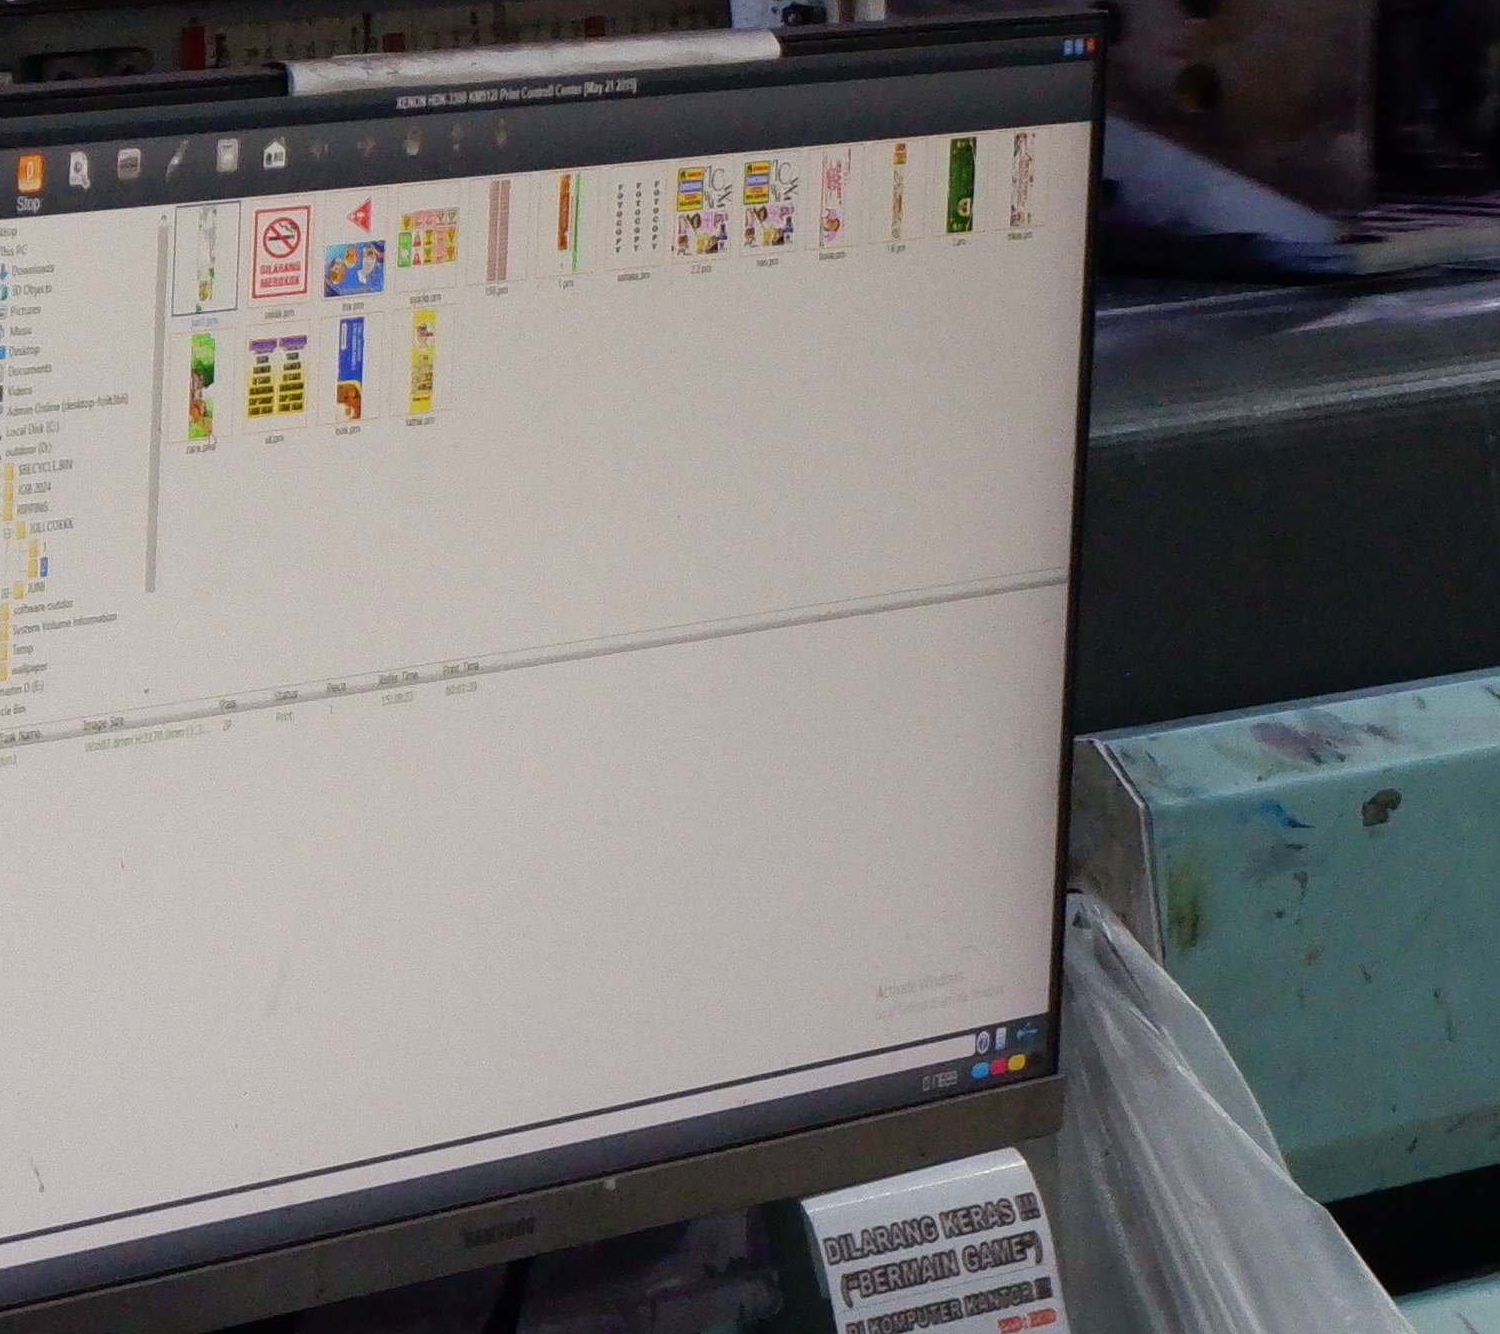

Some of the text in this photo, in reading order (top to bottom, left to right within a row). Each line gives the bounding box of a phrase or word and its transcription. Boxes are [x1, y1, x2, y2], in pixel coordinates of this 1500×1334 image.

[16, 196, 41, 212] Stop
[8, 345, 41, 358] Desktop
[13, 702, 27, 715] Bin
[822, 1215, 940, 1266] DILARANG
[938, 1197, 1017, 1240] KERAS
[961, 1280, 1036, 1318] KANTOR
